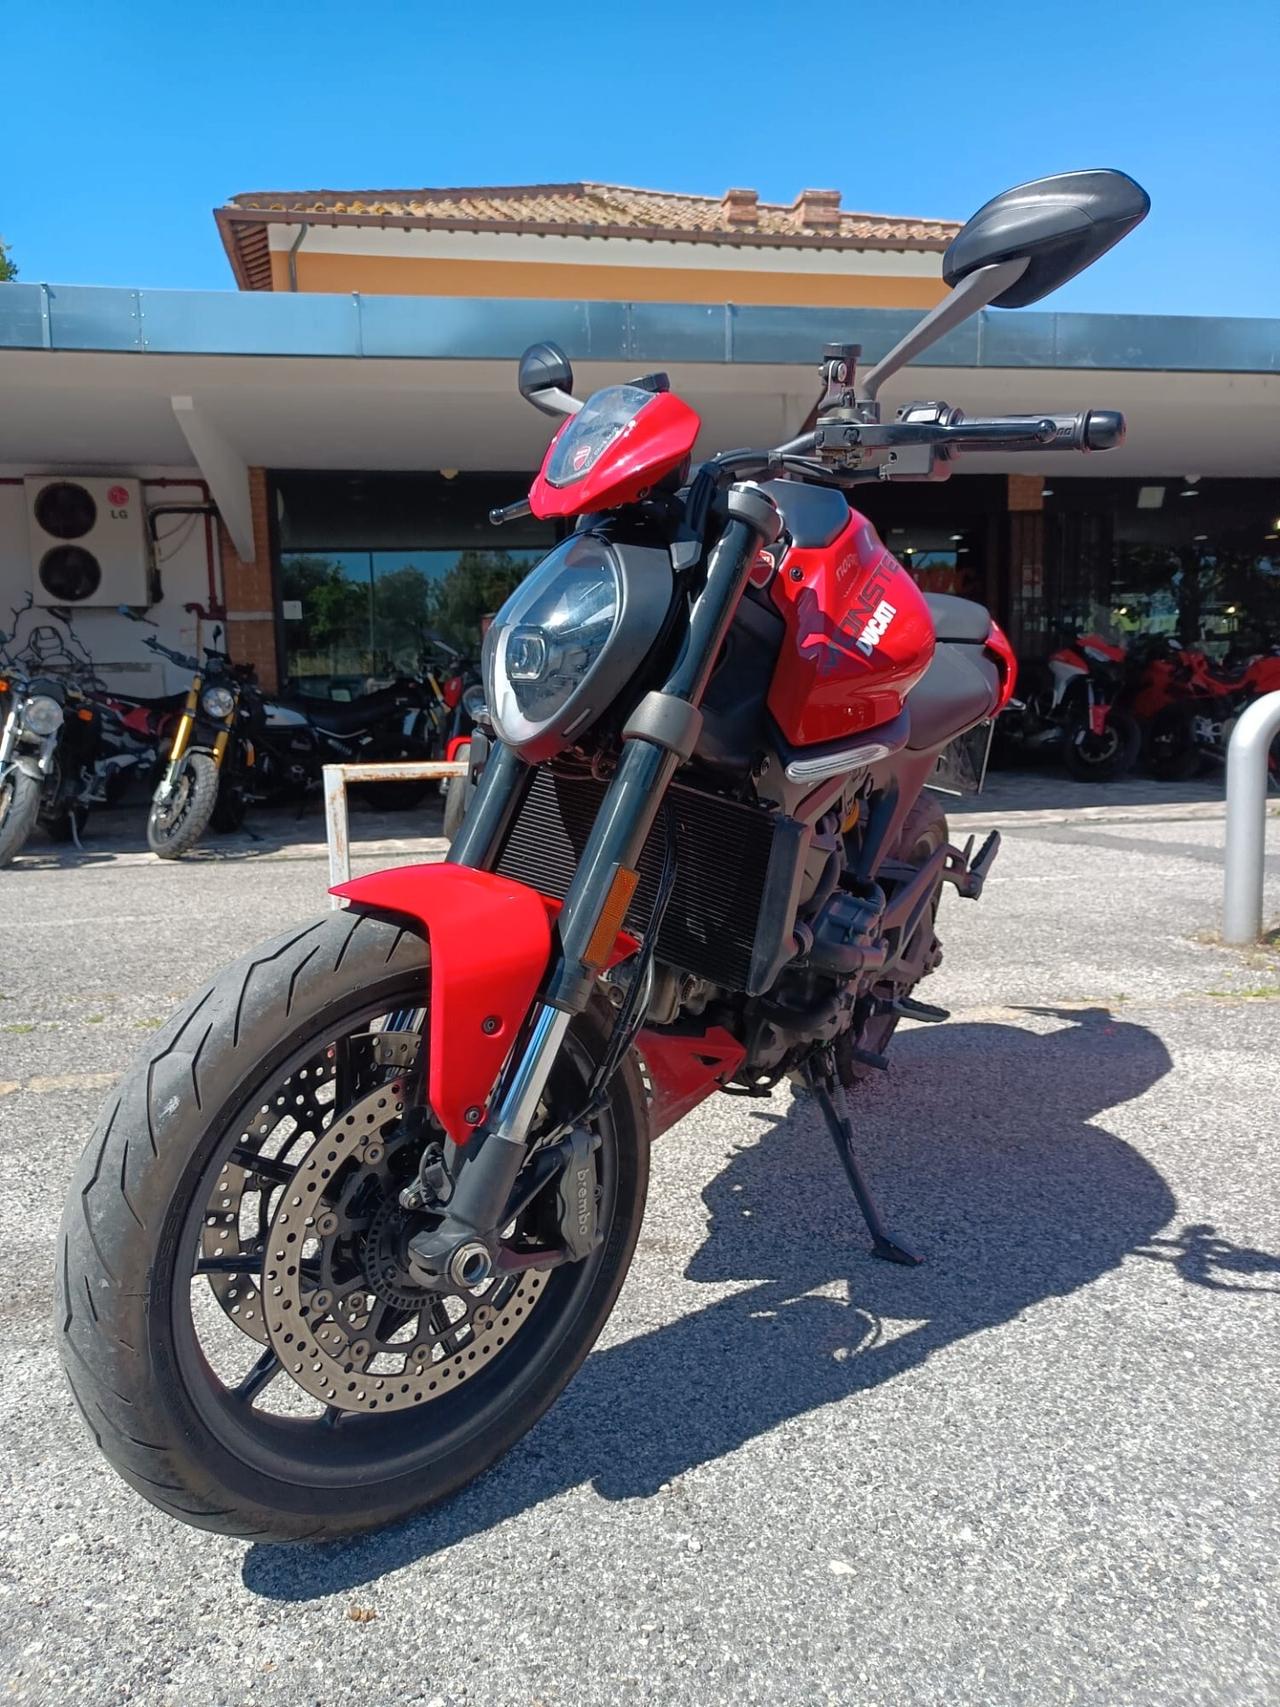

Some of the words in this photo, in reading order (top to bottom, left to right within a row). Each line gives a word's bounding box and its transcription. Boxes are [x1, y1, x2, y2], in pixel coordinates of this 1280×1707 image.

[110, 510, 129, 520] LG
[817, 551, 900, 678] MONSTE
[856, 599, 897, 657] DUCATI
[577, 1168, 591, 1235] brembo
